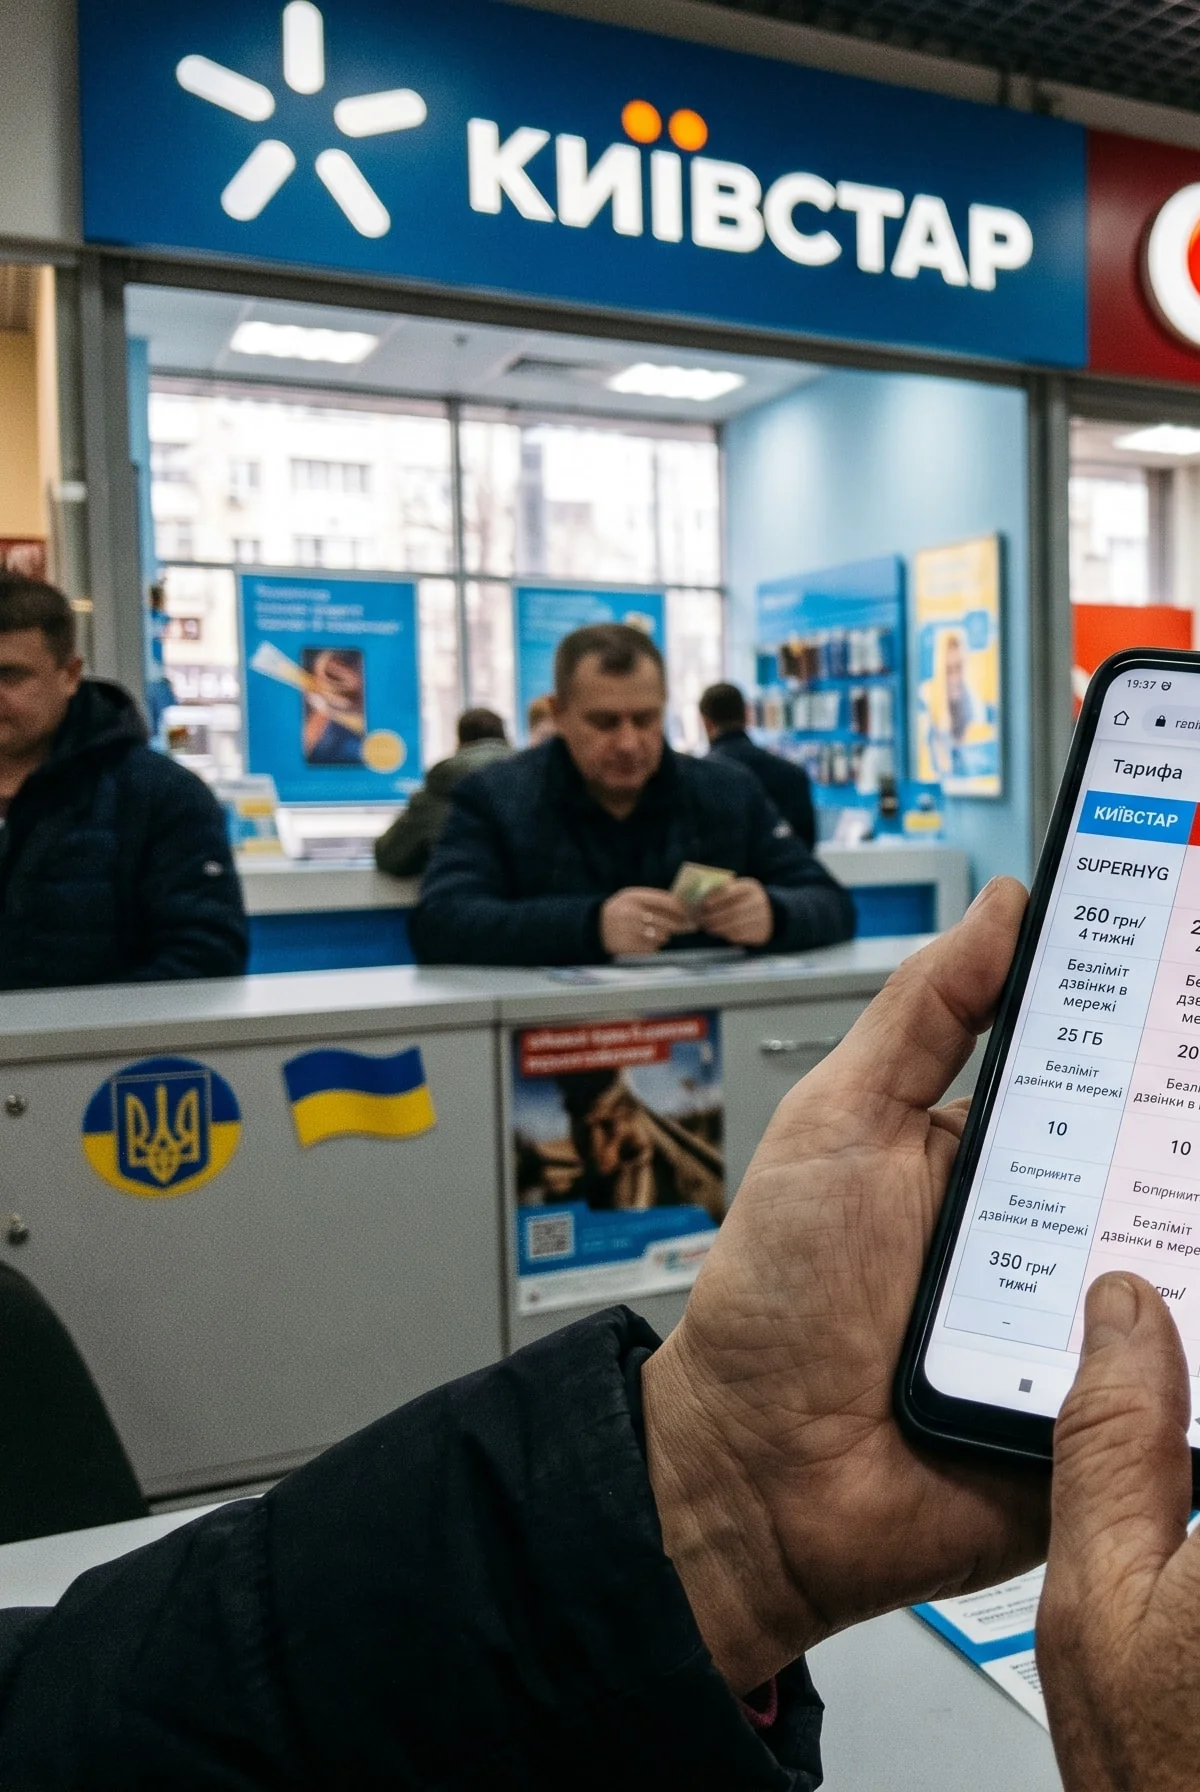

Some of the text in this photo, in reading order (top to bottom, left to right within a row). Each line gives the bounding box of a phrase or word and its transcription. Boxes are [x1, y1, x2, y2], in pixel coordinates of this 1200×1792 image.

[466, 98, 1034, 292] КИЇВСТАР
[1127, 679, 1157, 690] 19:37
[1113, 758, 1183, 783] Тарифа
[1094, 805, 1179, 828] КИЇВСТАР
[1076, 857, 1170, 881] SUPERHYG
[1073, 905, 1147, 930] 260 грн/
[1078, 927, 1136, 946] 4 тижні
[1067, 958, 1130, 977] Безліміт
[1058, 978, 1128, 996] дзвінки в
[1063, 996, 1117, 1013] мережі
[1056, 1027, 1104, 1046] 25 ГБ
[1177, 1044, 1200, 1060] 20
[1045, 1060, 1100, 1078] Безліміт
[1014, 1074, 1123, 1099] дзвінки в мережі
[1187, 1100, 1195, 1109] в
[1048, 1120, 1068, 1136] 10
[1171, 1139, 1192, 1156] 10
[1008, 1194, 1066, 1214] Безліміт
[978, 1209, 1089, 1237] дзвінки в мережі
[1100, 1230, 1152, 1247] дзвінки
[1155, 1240, 1164, 1249] в
[989, 1250, 1057, 1276] 350 грн/
